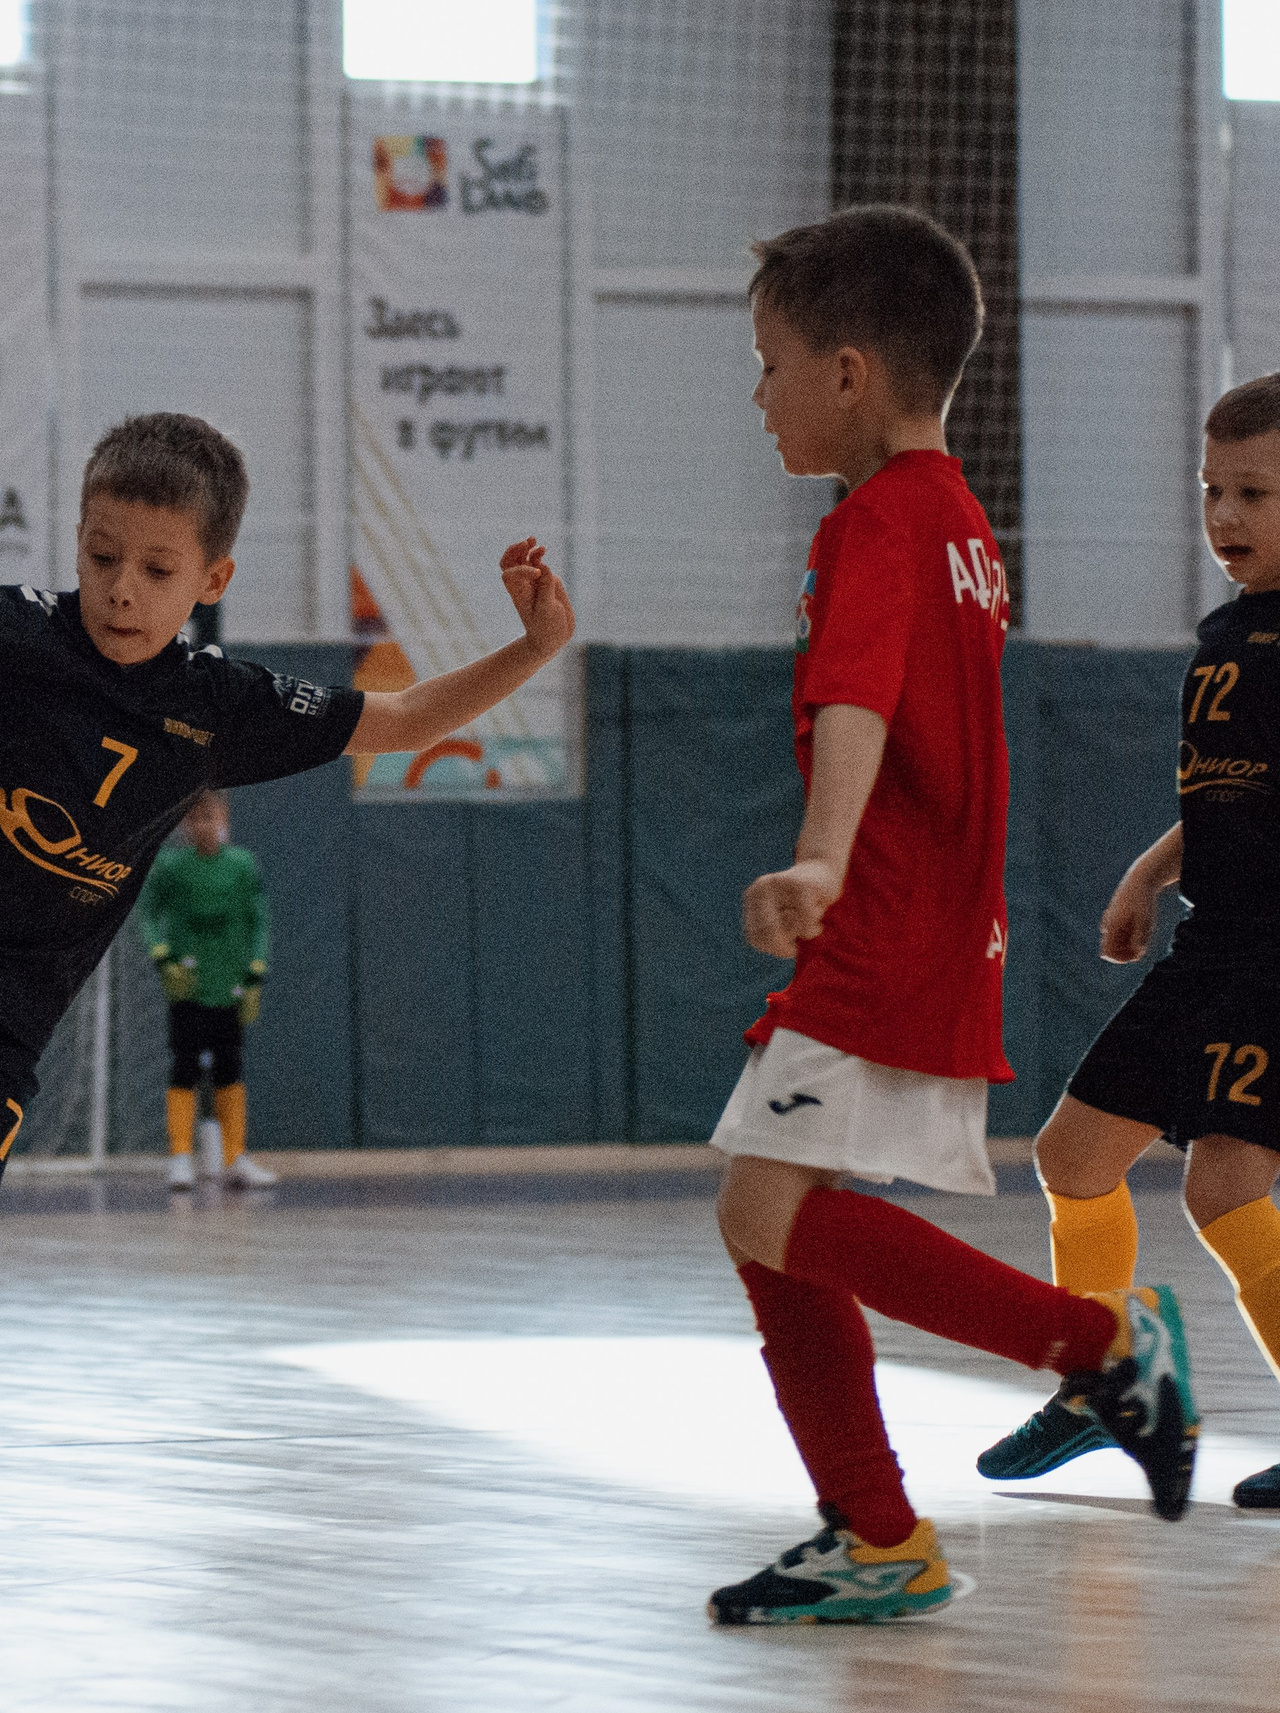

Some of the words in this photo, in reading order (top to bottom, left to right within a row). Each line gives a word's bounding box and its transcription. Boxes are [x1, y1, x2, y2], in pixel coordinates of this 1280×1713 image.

[1187, 660, 1242, 724] 72
[93, 736, 138, 808] 7
[1204, 1042, 1270, 1106] 72
